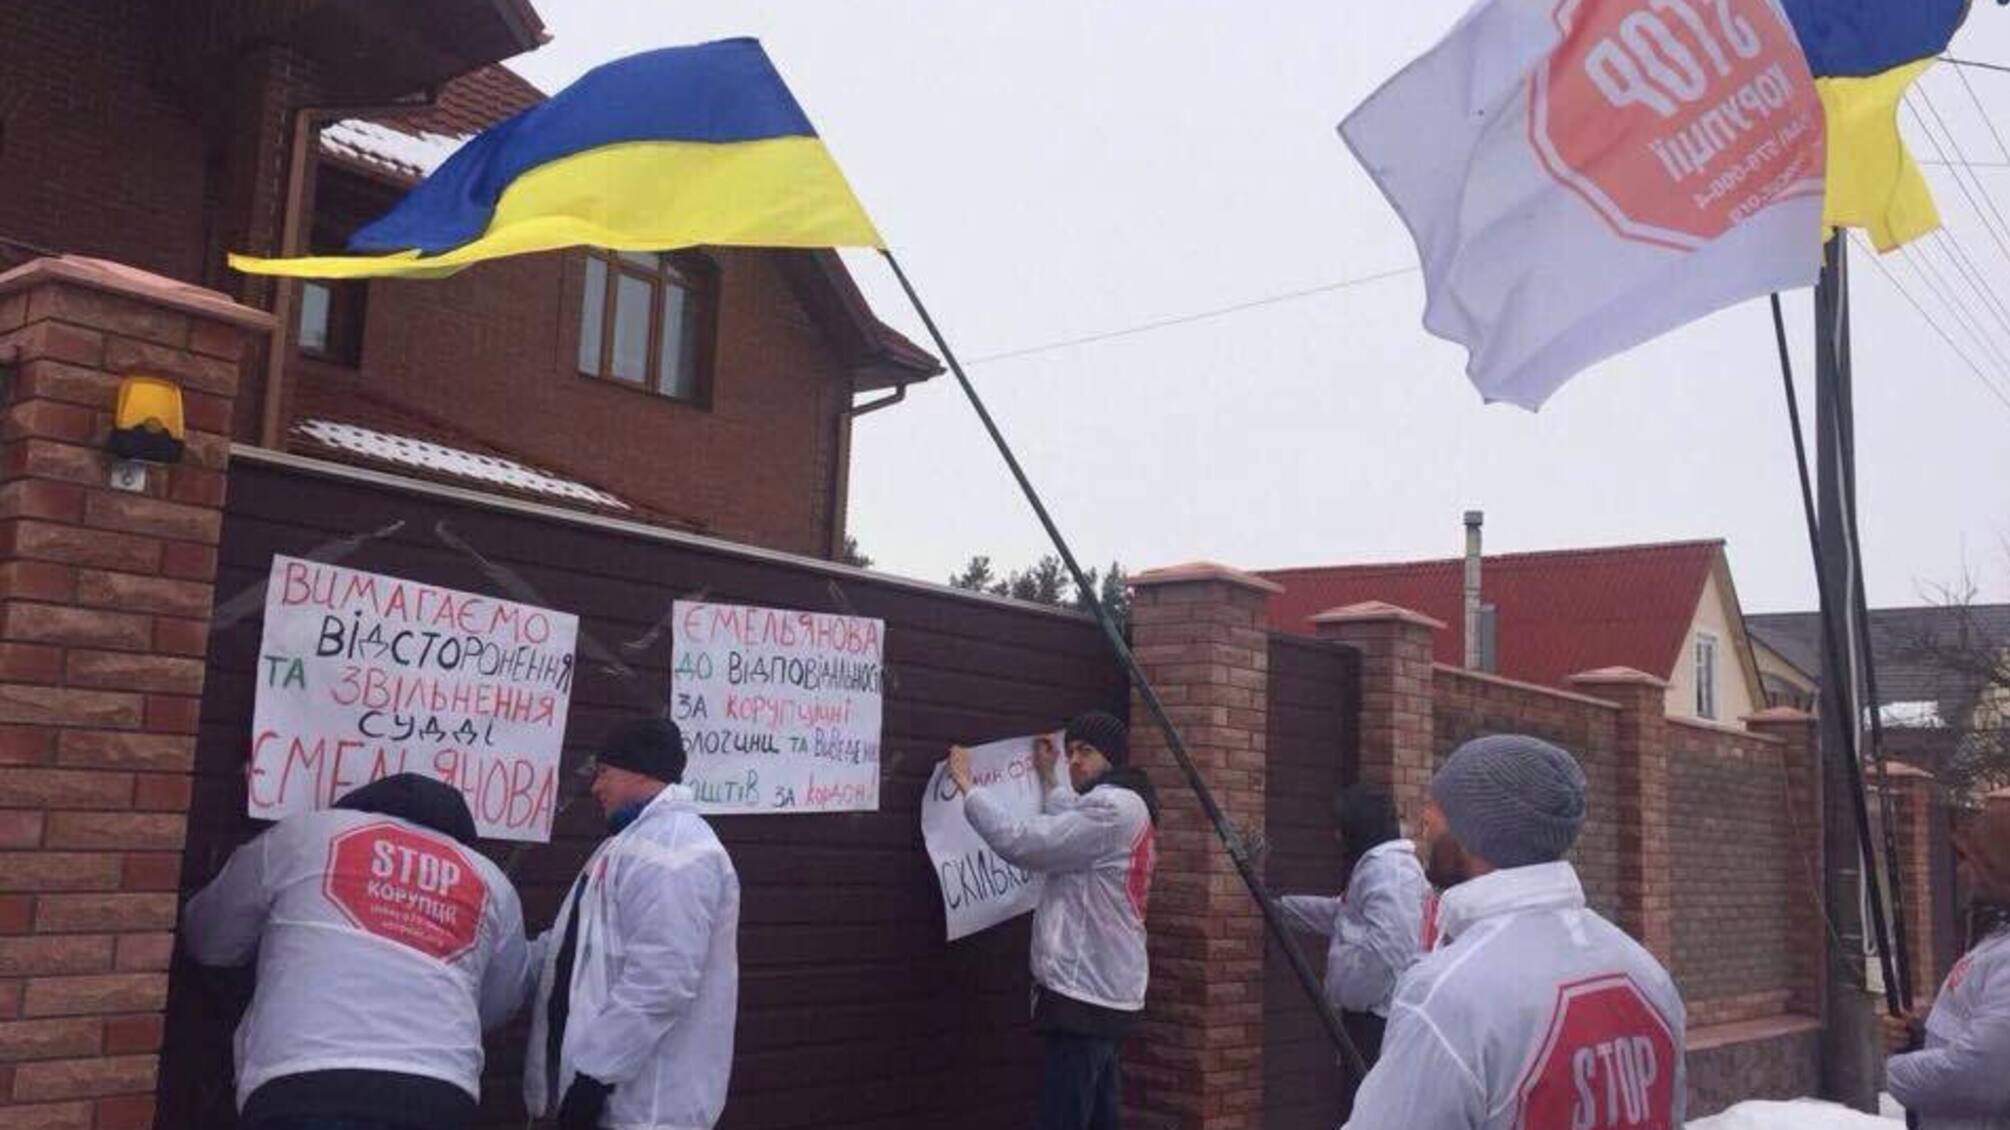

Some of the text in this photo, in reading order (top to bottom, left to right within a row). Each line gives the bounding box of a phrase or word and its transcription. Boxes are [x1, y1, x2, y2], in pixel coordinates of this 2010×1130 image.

[282, 562, 549, 643] ВИМАГАЄМО
[316, 611, 574, 693] ВІДСТОРОНЕННЯ
[674, 652, 713, 680] ДО
[264, 655, 554, 727] ТА ЗВІЛЬНЕННЯ
[677, 693, 707, 720] ЗА
[358, 711, 493, 746] СУДДІ
[789, 737, 808, 751] ТА
[247, 731, 554, 831] ЄМЕЛЯНОВА
[688, 770, 759, 804] ОШТІВ
[775, 786, 796, 808] ЗА
[371, 840, 461, 895] STOP
[1572, 1036, 1657, 1130] STOP
